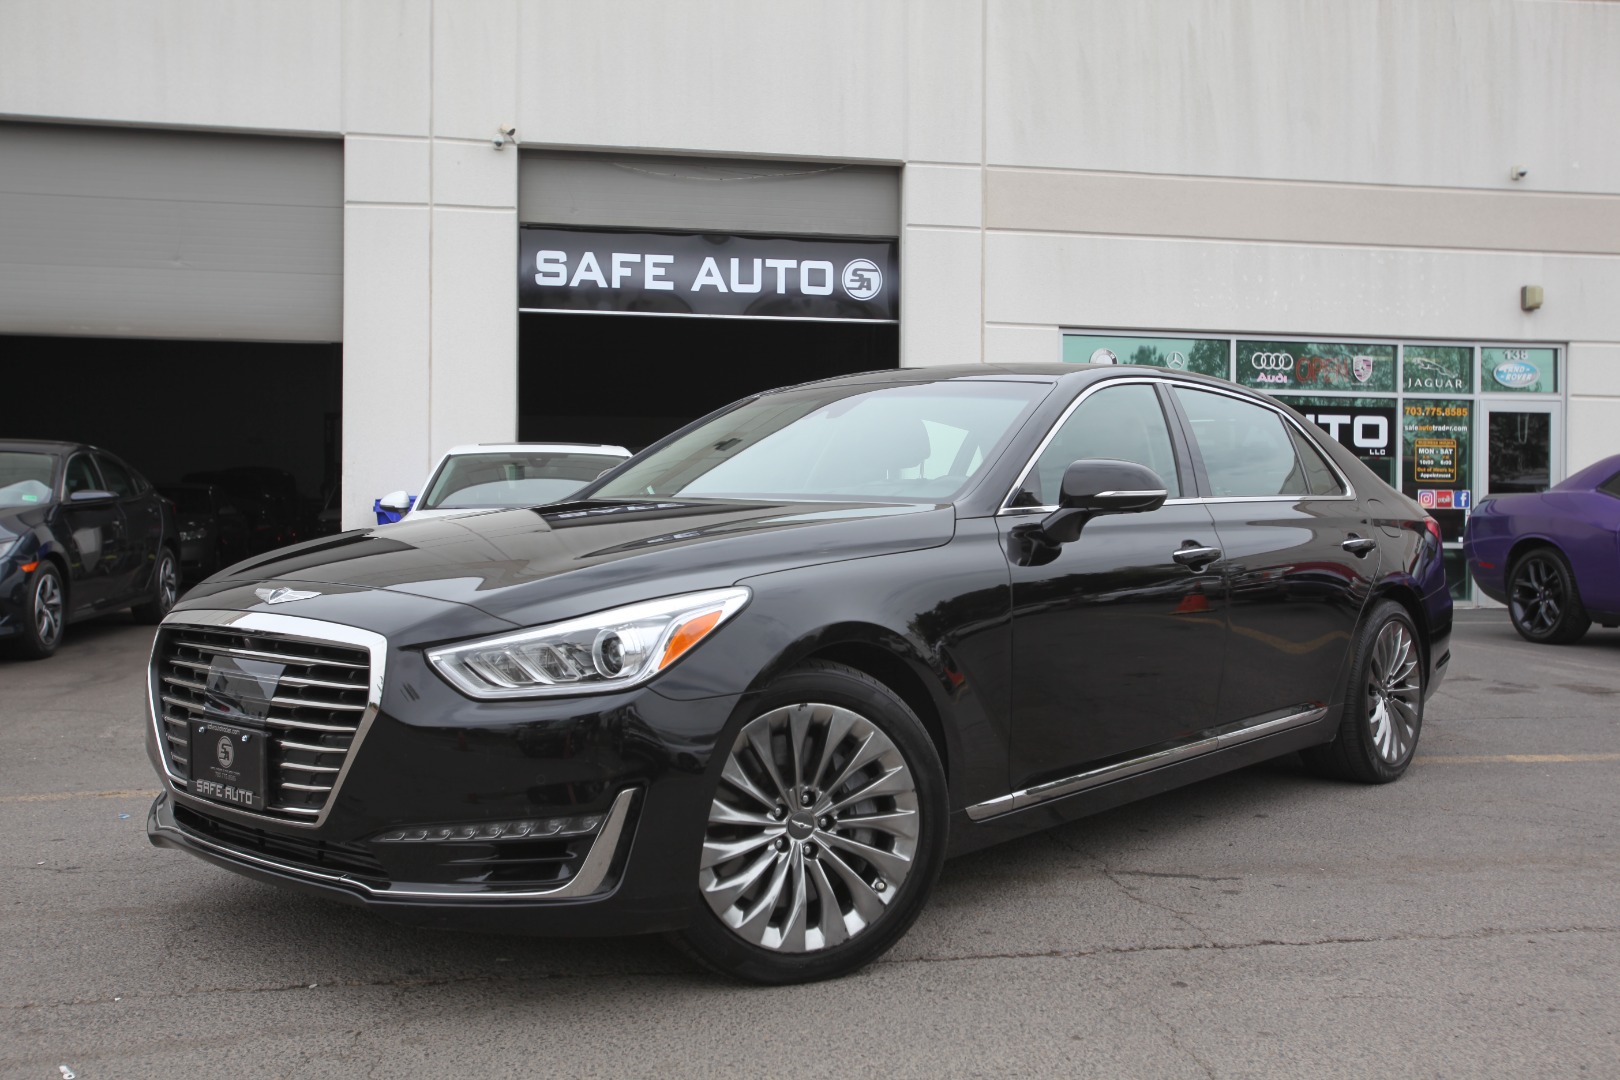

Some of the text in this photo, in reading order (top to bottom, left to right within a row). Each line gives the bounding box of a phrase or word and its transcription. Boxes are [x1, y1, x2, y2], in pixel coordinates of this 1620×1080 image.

[535, 250, 834, 296] SAFE AUTO
[1504, 350, 1529, 360] 138
[1295, 356, 1349, 384] OPEN
[1257, 372, 1288, 384] Audi
[1505, 373, 1533, 381] ROVER
[1408, 378, 1463, 389] JAGUAR
[1405, 406, 1468, 417] 703.775.8585
[196, 778, 254, 805] SAFE AUTO
